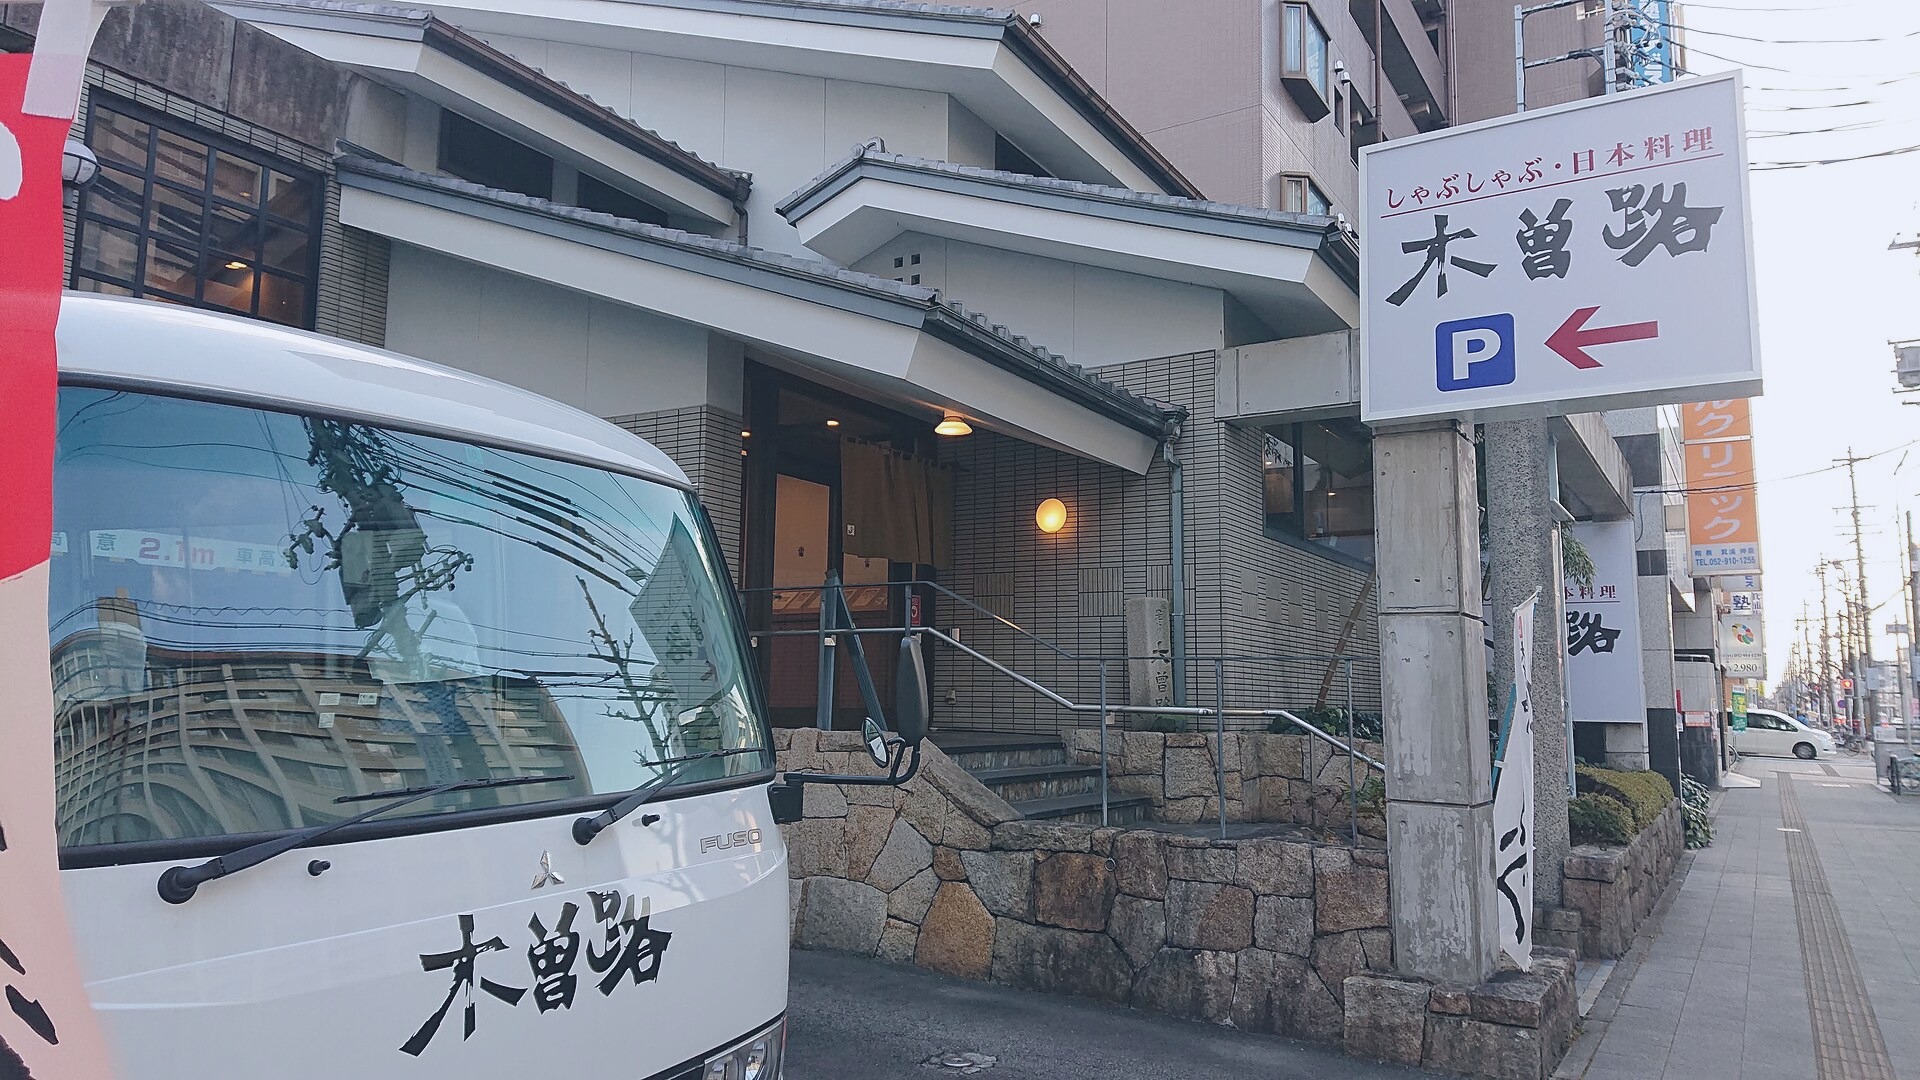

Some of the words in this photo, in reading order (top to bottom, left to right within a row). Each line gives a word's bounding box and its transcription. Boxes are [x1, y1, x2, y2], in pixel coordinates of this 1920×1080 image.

[1386, 126, 1714, 209] しゃぶしゃぶ・日本料理
[1385, 181, 1725, 307] 木曽路
[1451, 328, 1502, 381] P
[700, 828, 763, 854] FUSO
[398, 890, 673, 1058] 木曽路
